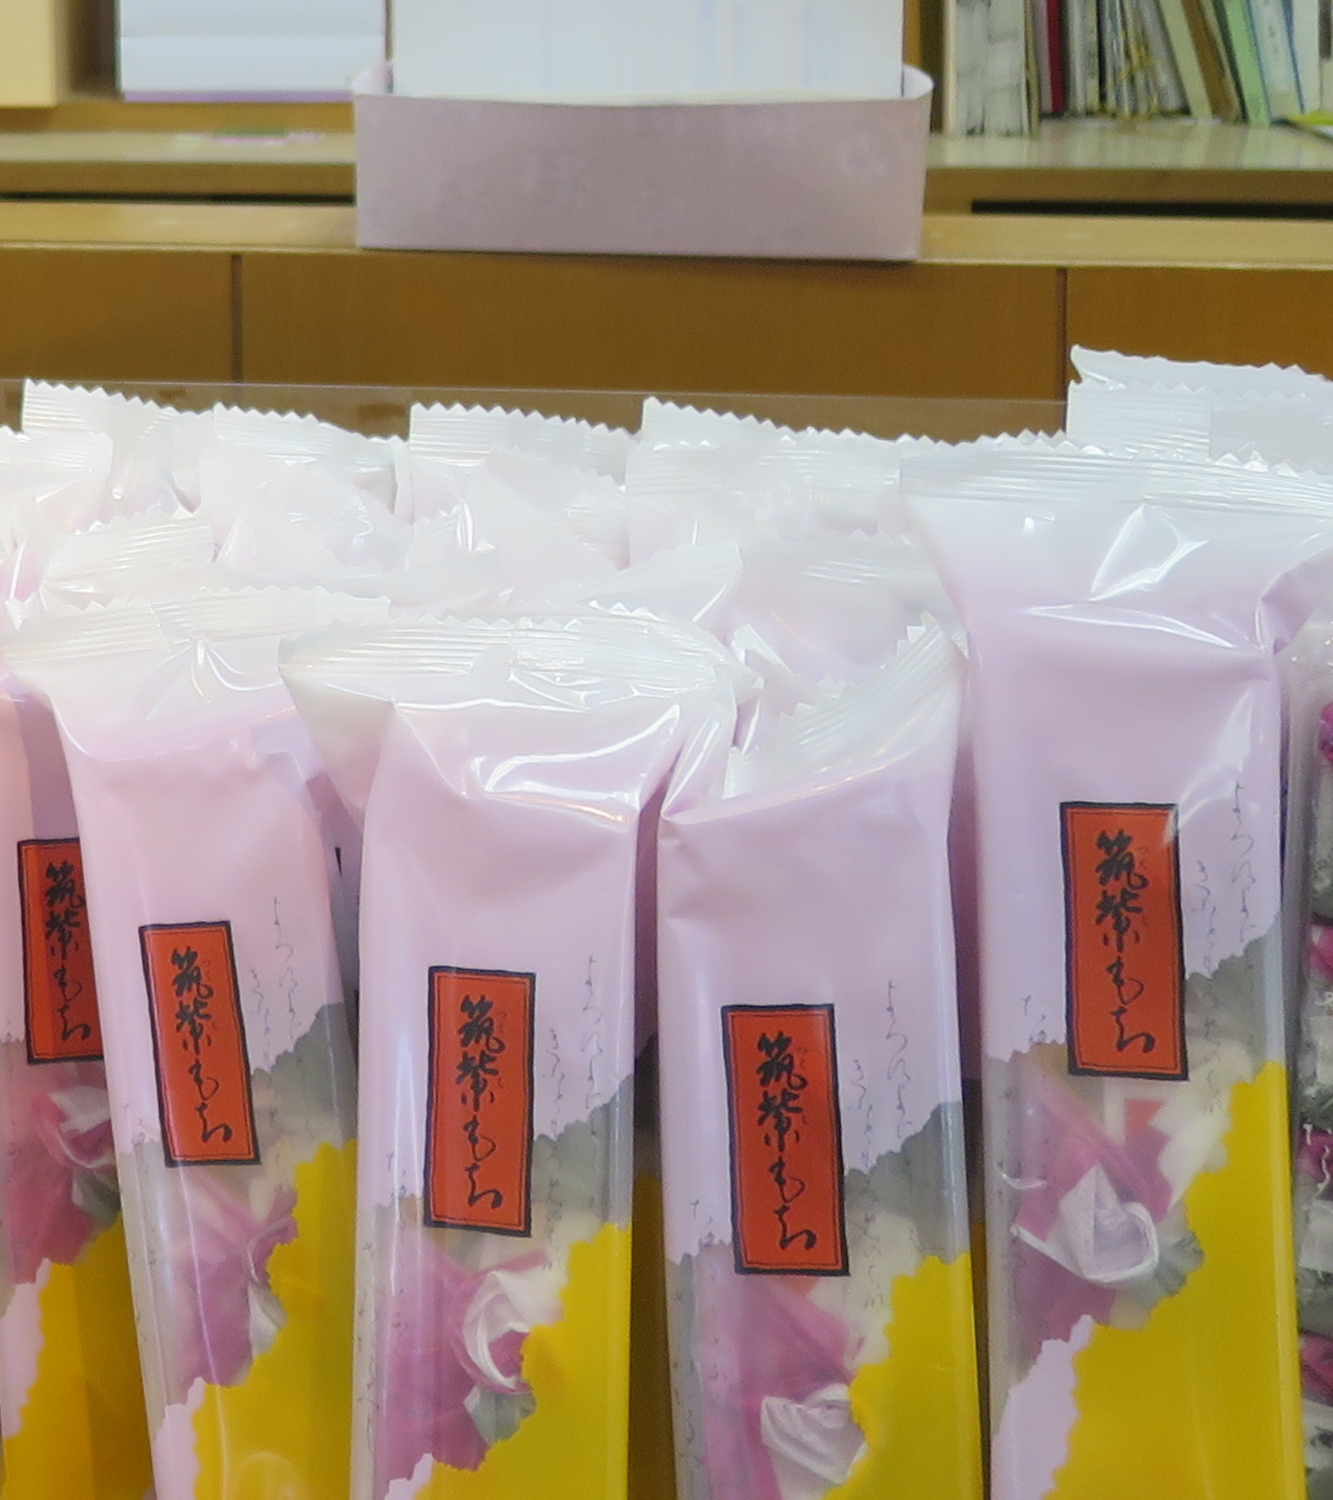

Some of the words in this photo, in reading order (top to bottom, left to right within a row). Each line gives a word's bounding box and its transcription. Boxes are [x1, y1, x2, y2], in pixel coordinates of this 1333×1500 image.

[171, 946, 233, 1143] 筑紫もち
[1093, 829, 1158, 1054] 筑紫もち
[455, 993, 507, 1212] 筑紫もち
[755, 1031, 819, 1251] 筑紫もち
